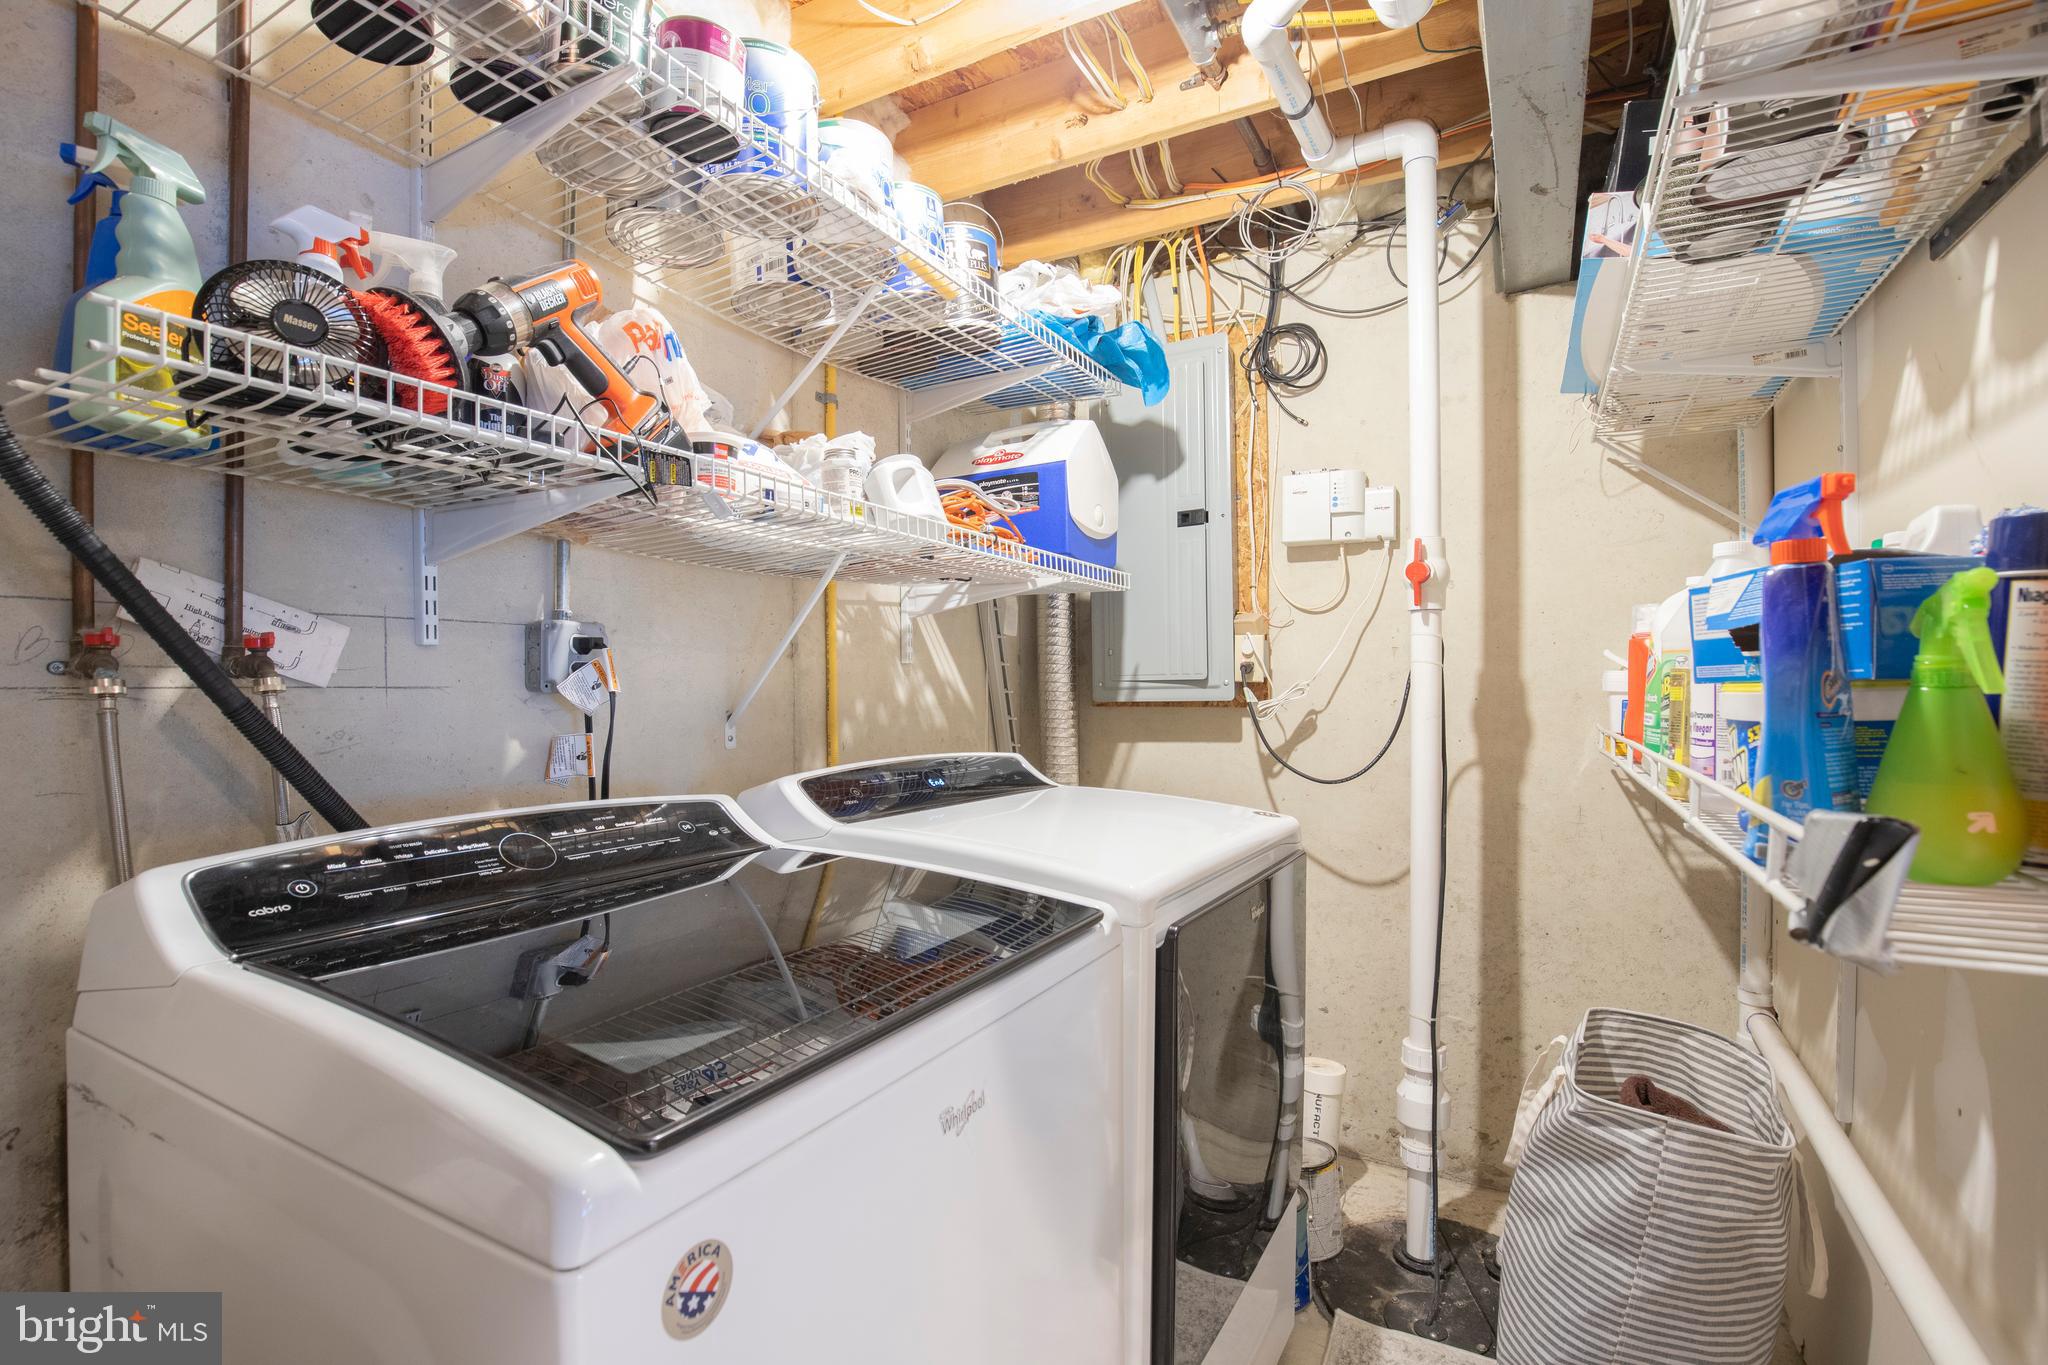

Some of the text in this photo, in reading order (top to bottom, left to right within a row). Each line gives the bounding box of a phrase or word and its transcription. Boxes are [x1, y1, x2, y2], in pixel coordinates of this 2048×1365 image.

[539, 293, 567, 311] DECKER
[283, 313, 318, 332] Massey
[975, 453, 1022, 466] playmate
[979, 478, 1007, 488] playmate
[184, 603, 203, 616] High
[928, 778, 945, 788] End
[327, 862, 347, 870] Mixed
[394, 852, 414, 860] Whites
[248, 904, 292, 918] cabrio
[939, 1089, 985, 1135] Whirlpool
[665, 1242, 721, 1307] AMERICA
